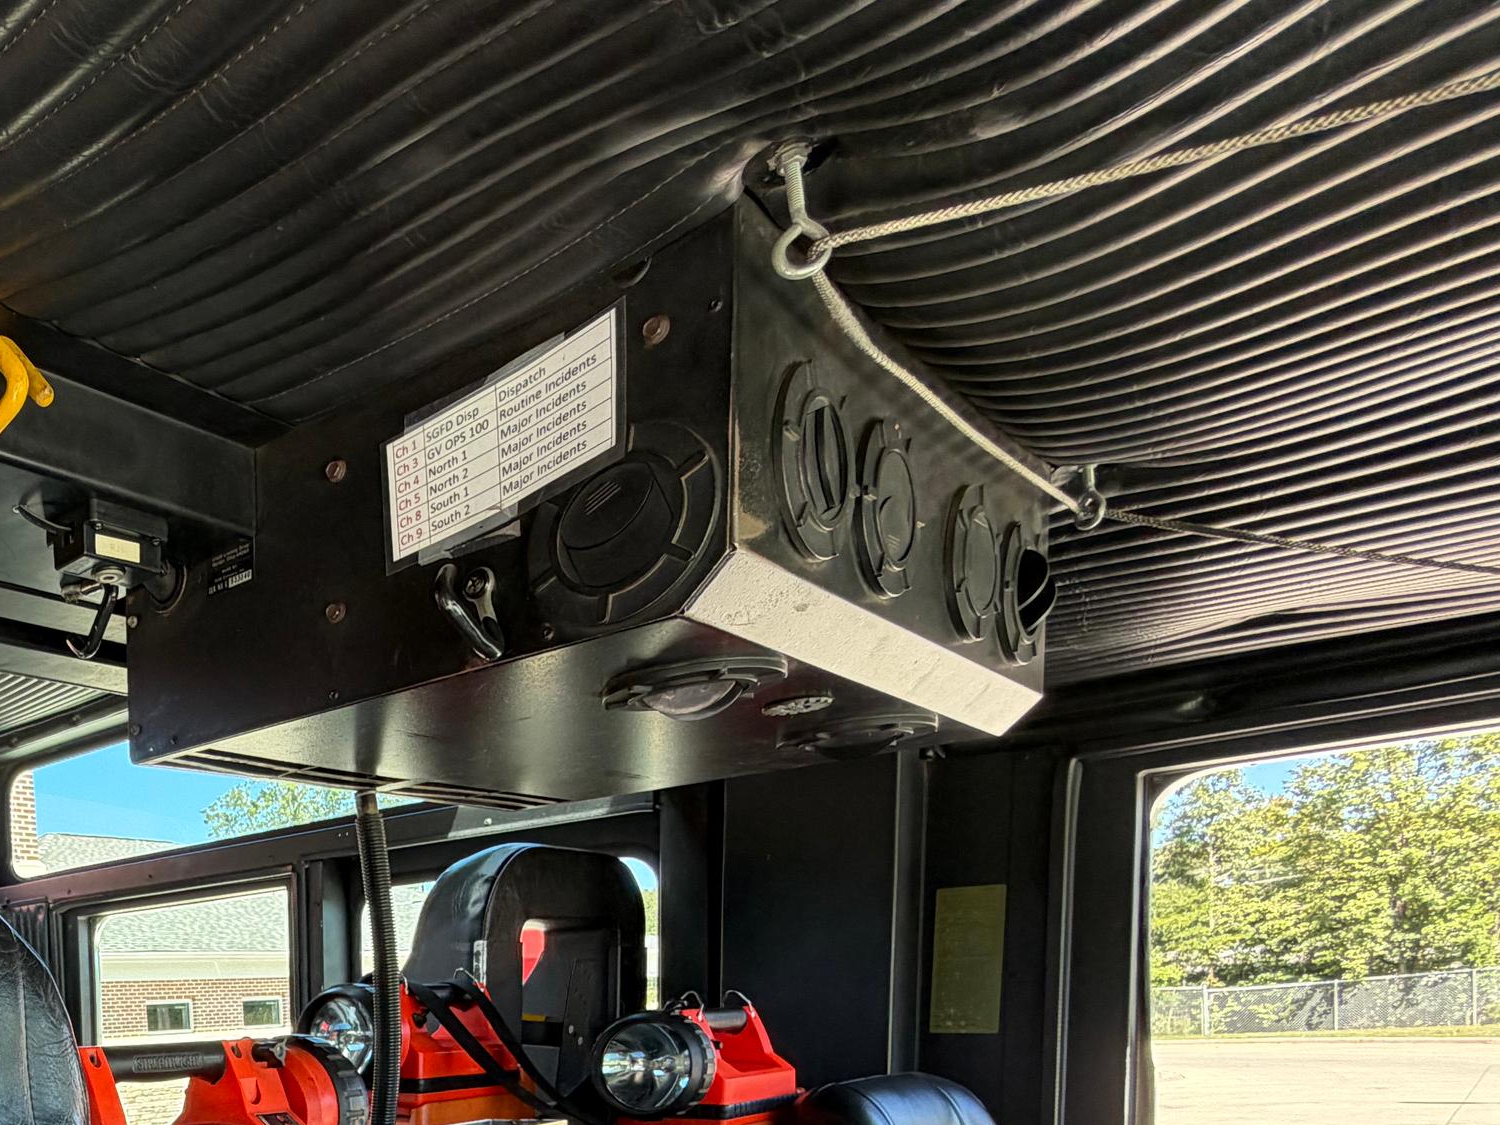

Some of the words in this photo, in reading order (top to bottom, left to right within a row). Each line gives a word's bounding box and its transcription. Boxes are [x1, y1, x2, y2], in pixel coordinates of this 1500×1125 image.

[395, 445, 409, 459] Ch
[412, 440, 417, 451] 1
[426, 420, 453, 443] SGFD
[456, 407, 479, 426] Disp
[498, 366, 546, 403] Dispatch
[396, 462, 410, 476] Ch
[412, 457, 419, 469] 3
[427, 445, 442, 460] GV
[445, 432, 466, 451] OPS
[470, 419, 489, 438] 100
[499, 389, 542, 421] Routine
[545, 354, 597, 394] Incidents
[397, 480, 411, 494] Ch
[413, 475, 420, 486] 4
[428, 455, 458, 478] North
[462, 450, 468, 461] 1
[500, 414, 533, 440] Major
[535, 380, 587, 419] Incidents
[398, 497, 412, 511] Ch
[414, 492, 421, 504] 5
[429, 472, 459, 496] North
[462, 468, 469, 479] 2
[501, 433, 534, 459] Major
[536, 400, 587, 438] Incidents
[400, 515, 413, 528] Ch
[415, 510, 422, 521] 8
[430, 491, 460, 514] South
[463, 486, 469, 497] 1
[501, 452, 534, 477] Major
[536, 420, 587, 457] Incidents
[400, 532, 414, 546] Ch
[416, 528, 423, 538] 9
[431, 509, 461, 532] South
[464, 504, 470, 515] 2
[502, 471, 535, 497] Major
[537, 439, 587, 476] Incidents
